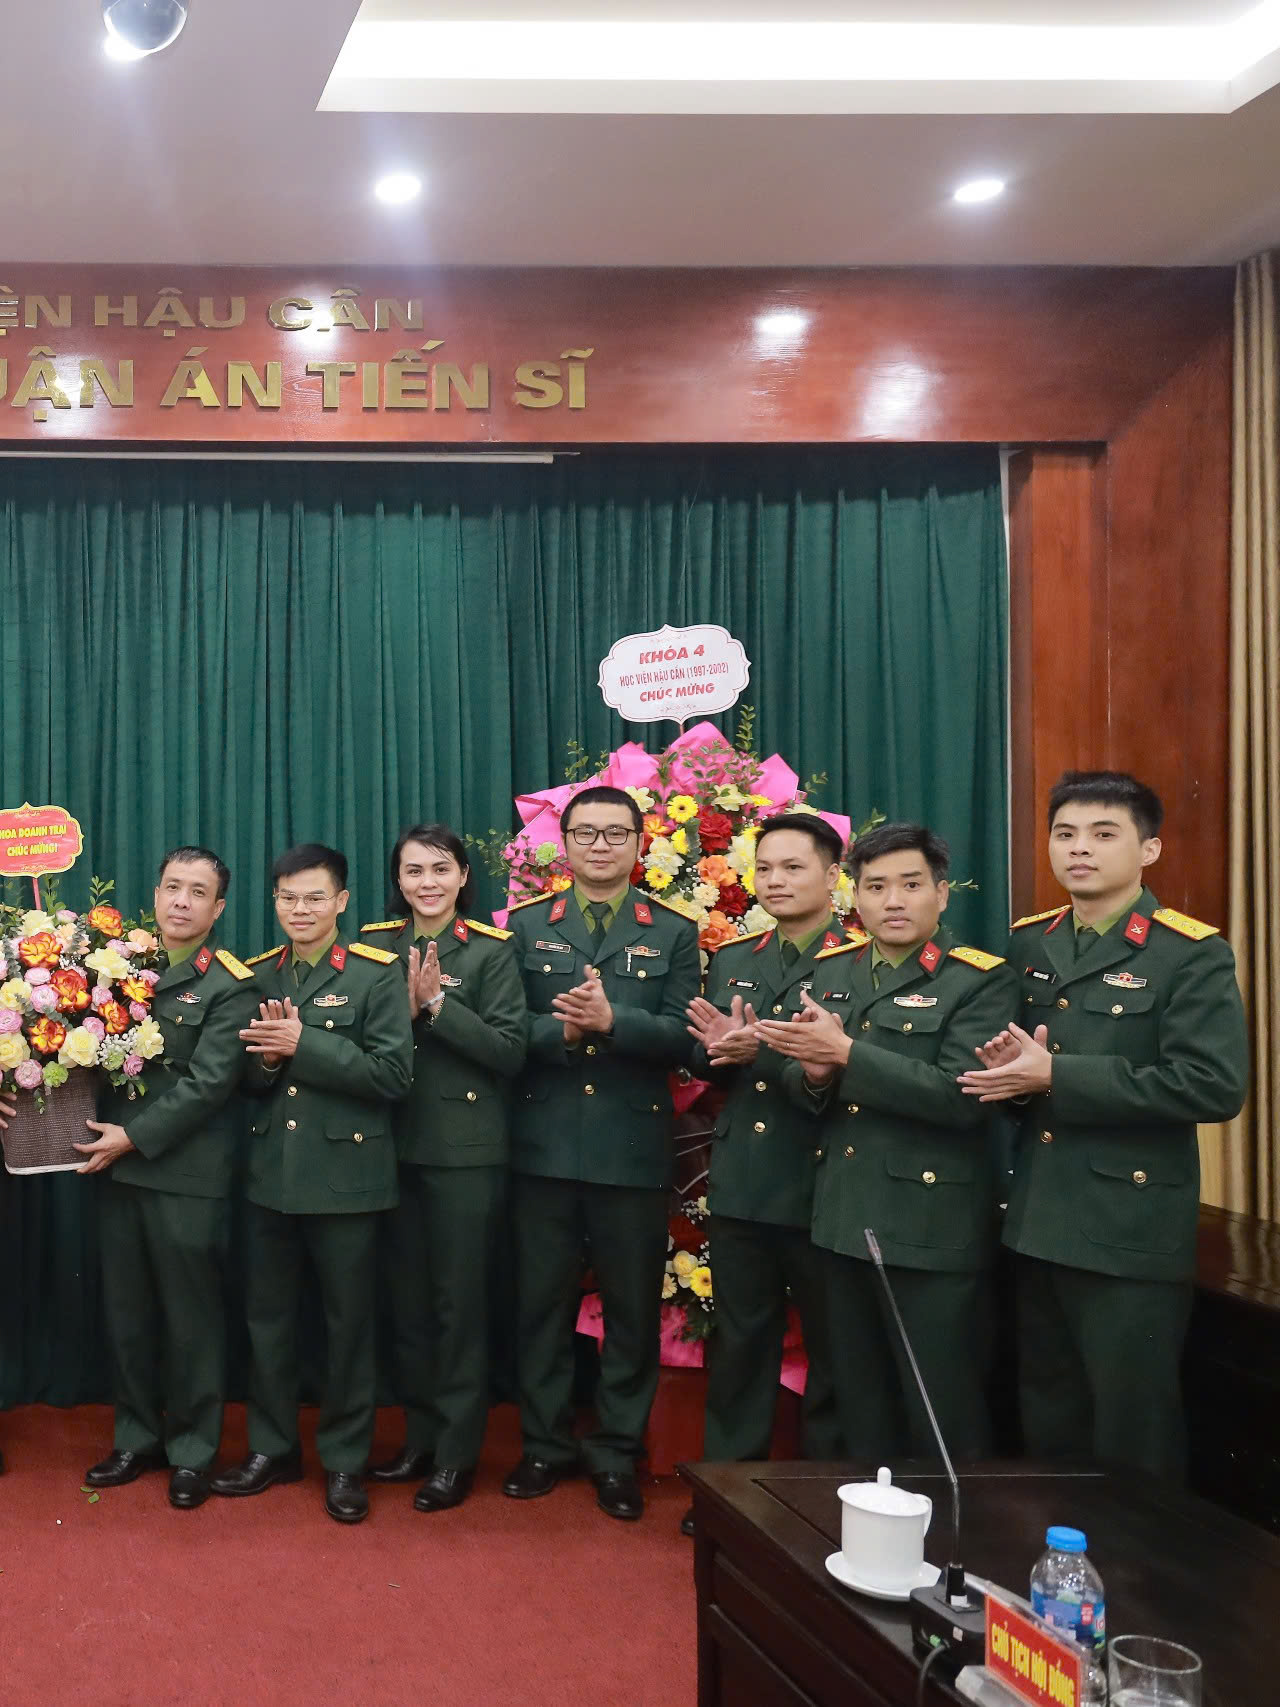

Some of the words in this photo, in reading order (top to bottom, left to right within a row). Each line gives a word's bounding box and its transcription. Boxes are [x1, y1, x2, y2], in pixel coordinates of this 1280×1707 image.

[93, 287, 246, 337] HẬU
[160, 347, 282, 408] ÁN
[307, 340, 489, 410] TIẾN
[514, 347, 595, 410] SĨ
[639, 645, 689, 664] KHÓA
[693, 644, 705, 657] 4
[619, 674, 635, 689] HỌC
[636, 670, 653, 687] VIỆN
[639, 686, 673, 702] CHÚC
[675, 682, 716, 698] MỪNG
[18, 825, 49, 839] DOANH
[6, 842, 29, 857] CHÚC
[991, 1621, 1009, 1663] CHỦ
[1010, 1635, 1030, 1679] TỊCH
